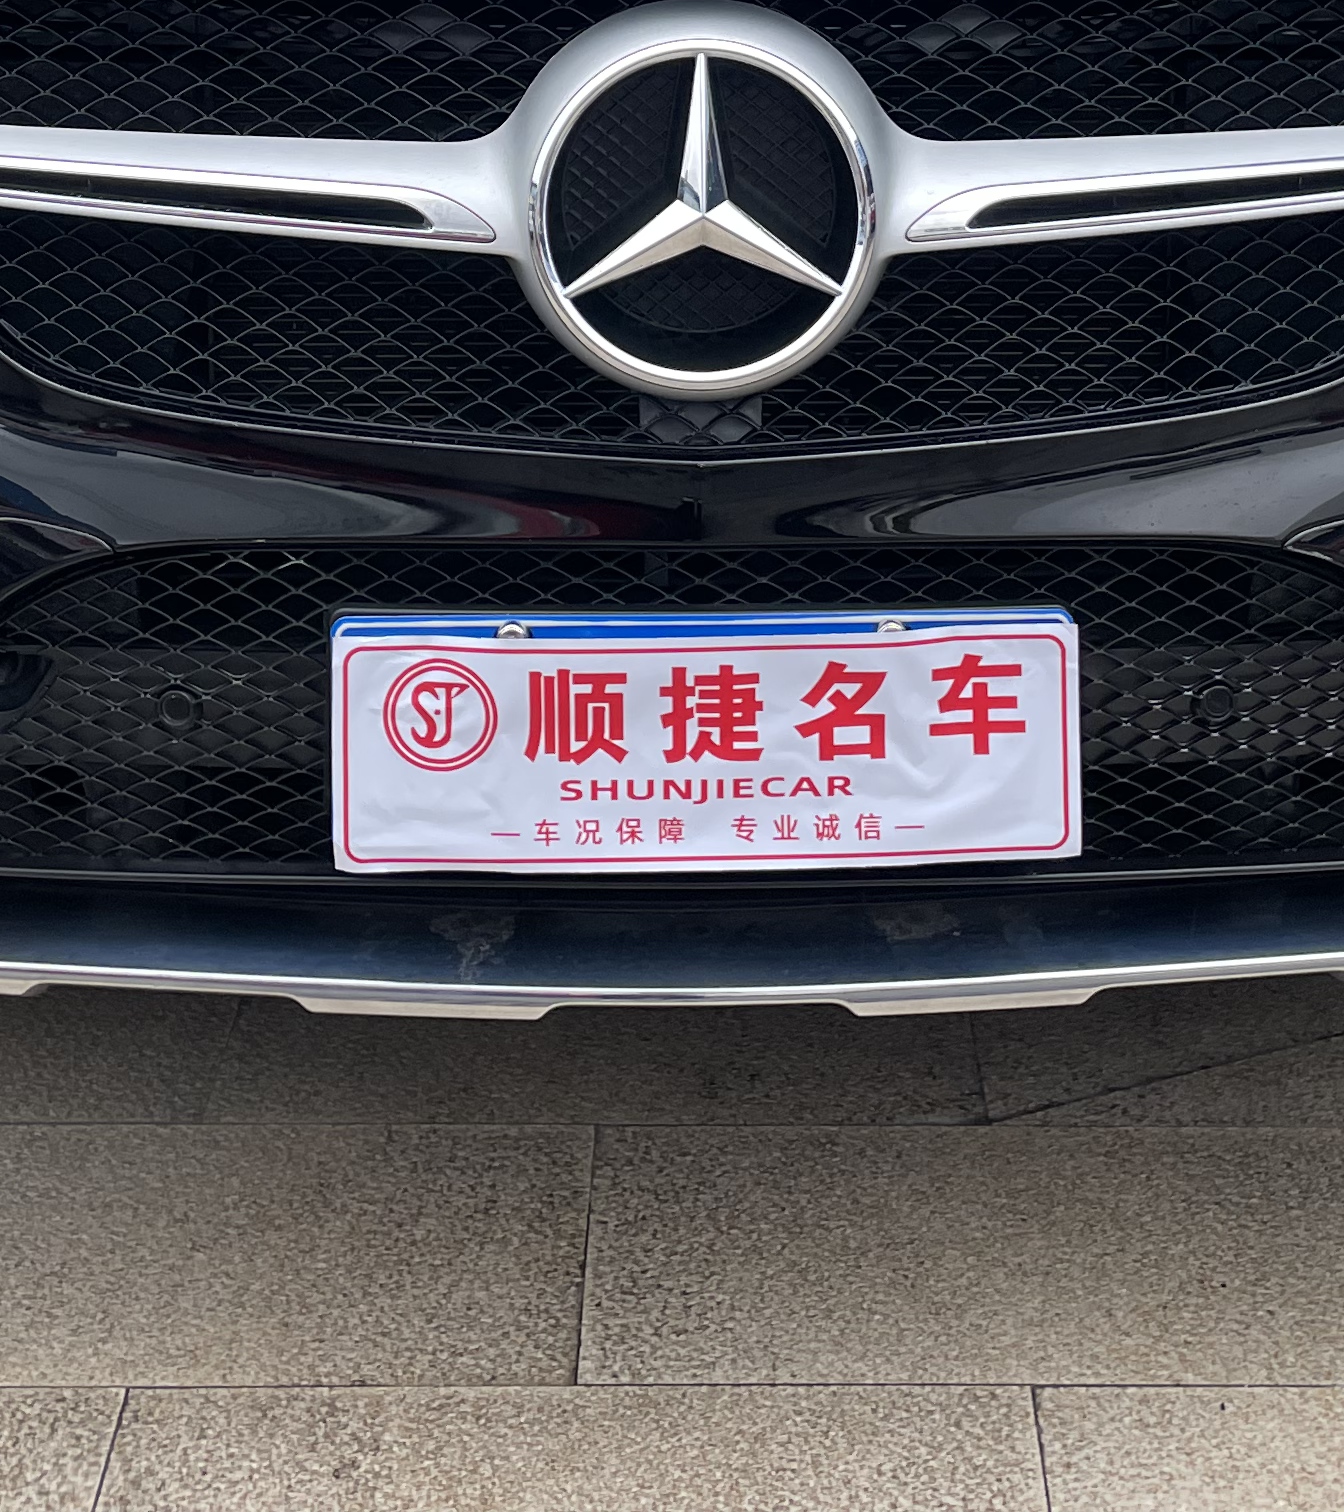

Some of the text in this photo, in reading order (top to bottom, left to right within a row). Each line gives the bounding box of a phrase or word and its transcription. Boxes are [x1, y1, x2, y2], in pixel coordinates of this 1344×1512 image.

[524, 653, 1027, 764] 顺捷名车
[560, 775, 853, 805] SHUNJIECAR
[534, 813, 882, 846] 车况保障 专业诚信
